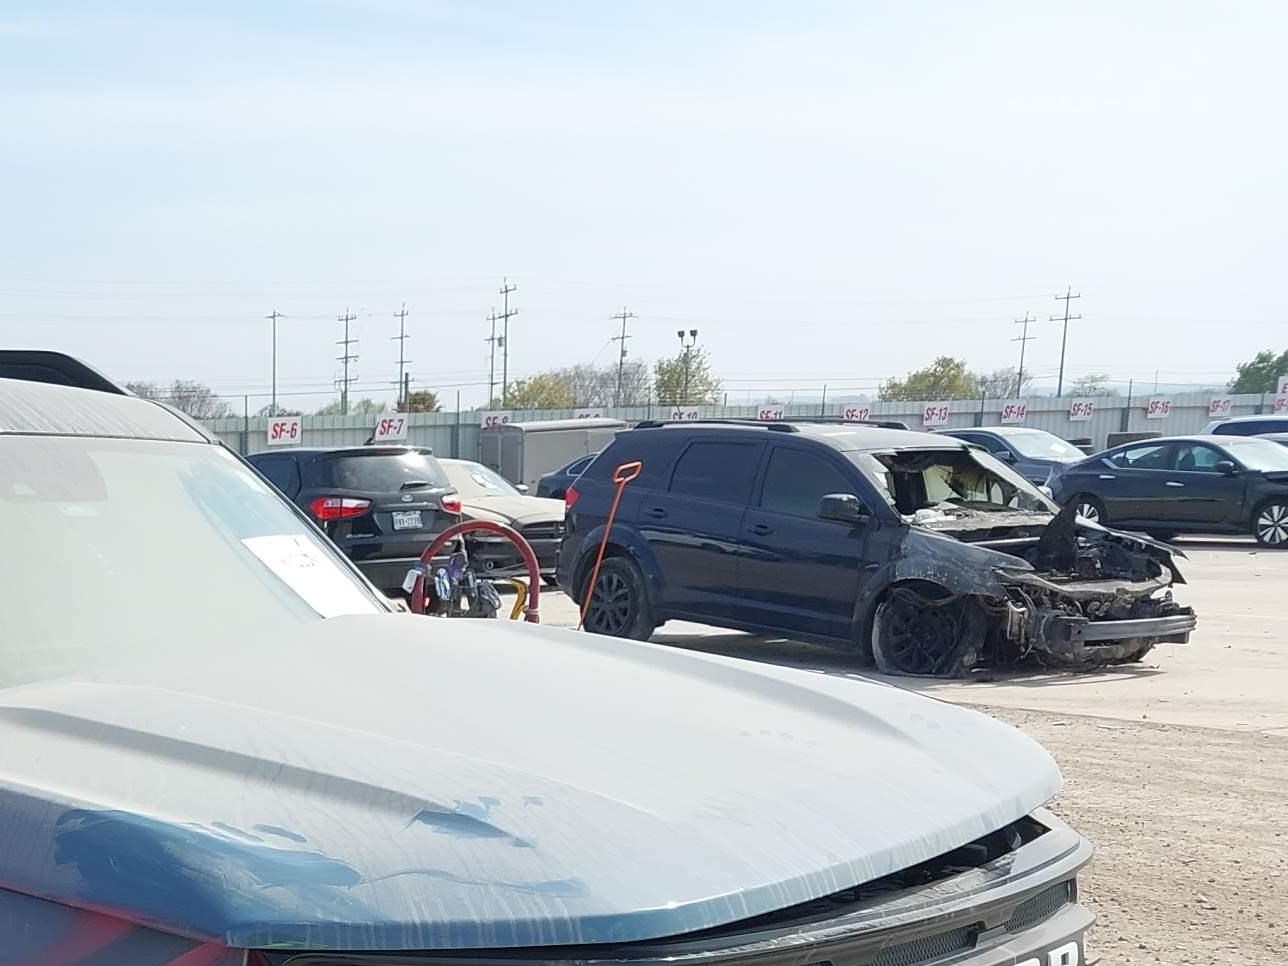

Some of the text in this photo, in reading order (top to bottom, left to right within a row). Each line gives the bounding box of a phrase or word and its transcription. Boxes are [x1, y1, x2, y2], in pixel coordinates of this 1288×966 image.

[924, 407, 949, 421] SF-13
[1003, 405, 1026, 418] SF-14
[1071, 402, 1094, 417] SF-15
[271, 422, 298, 440] SF-6
[379, 418, 404, 436] SF-7
